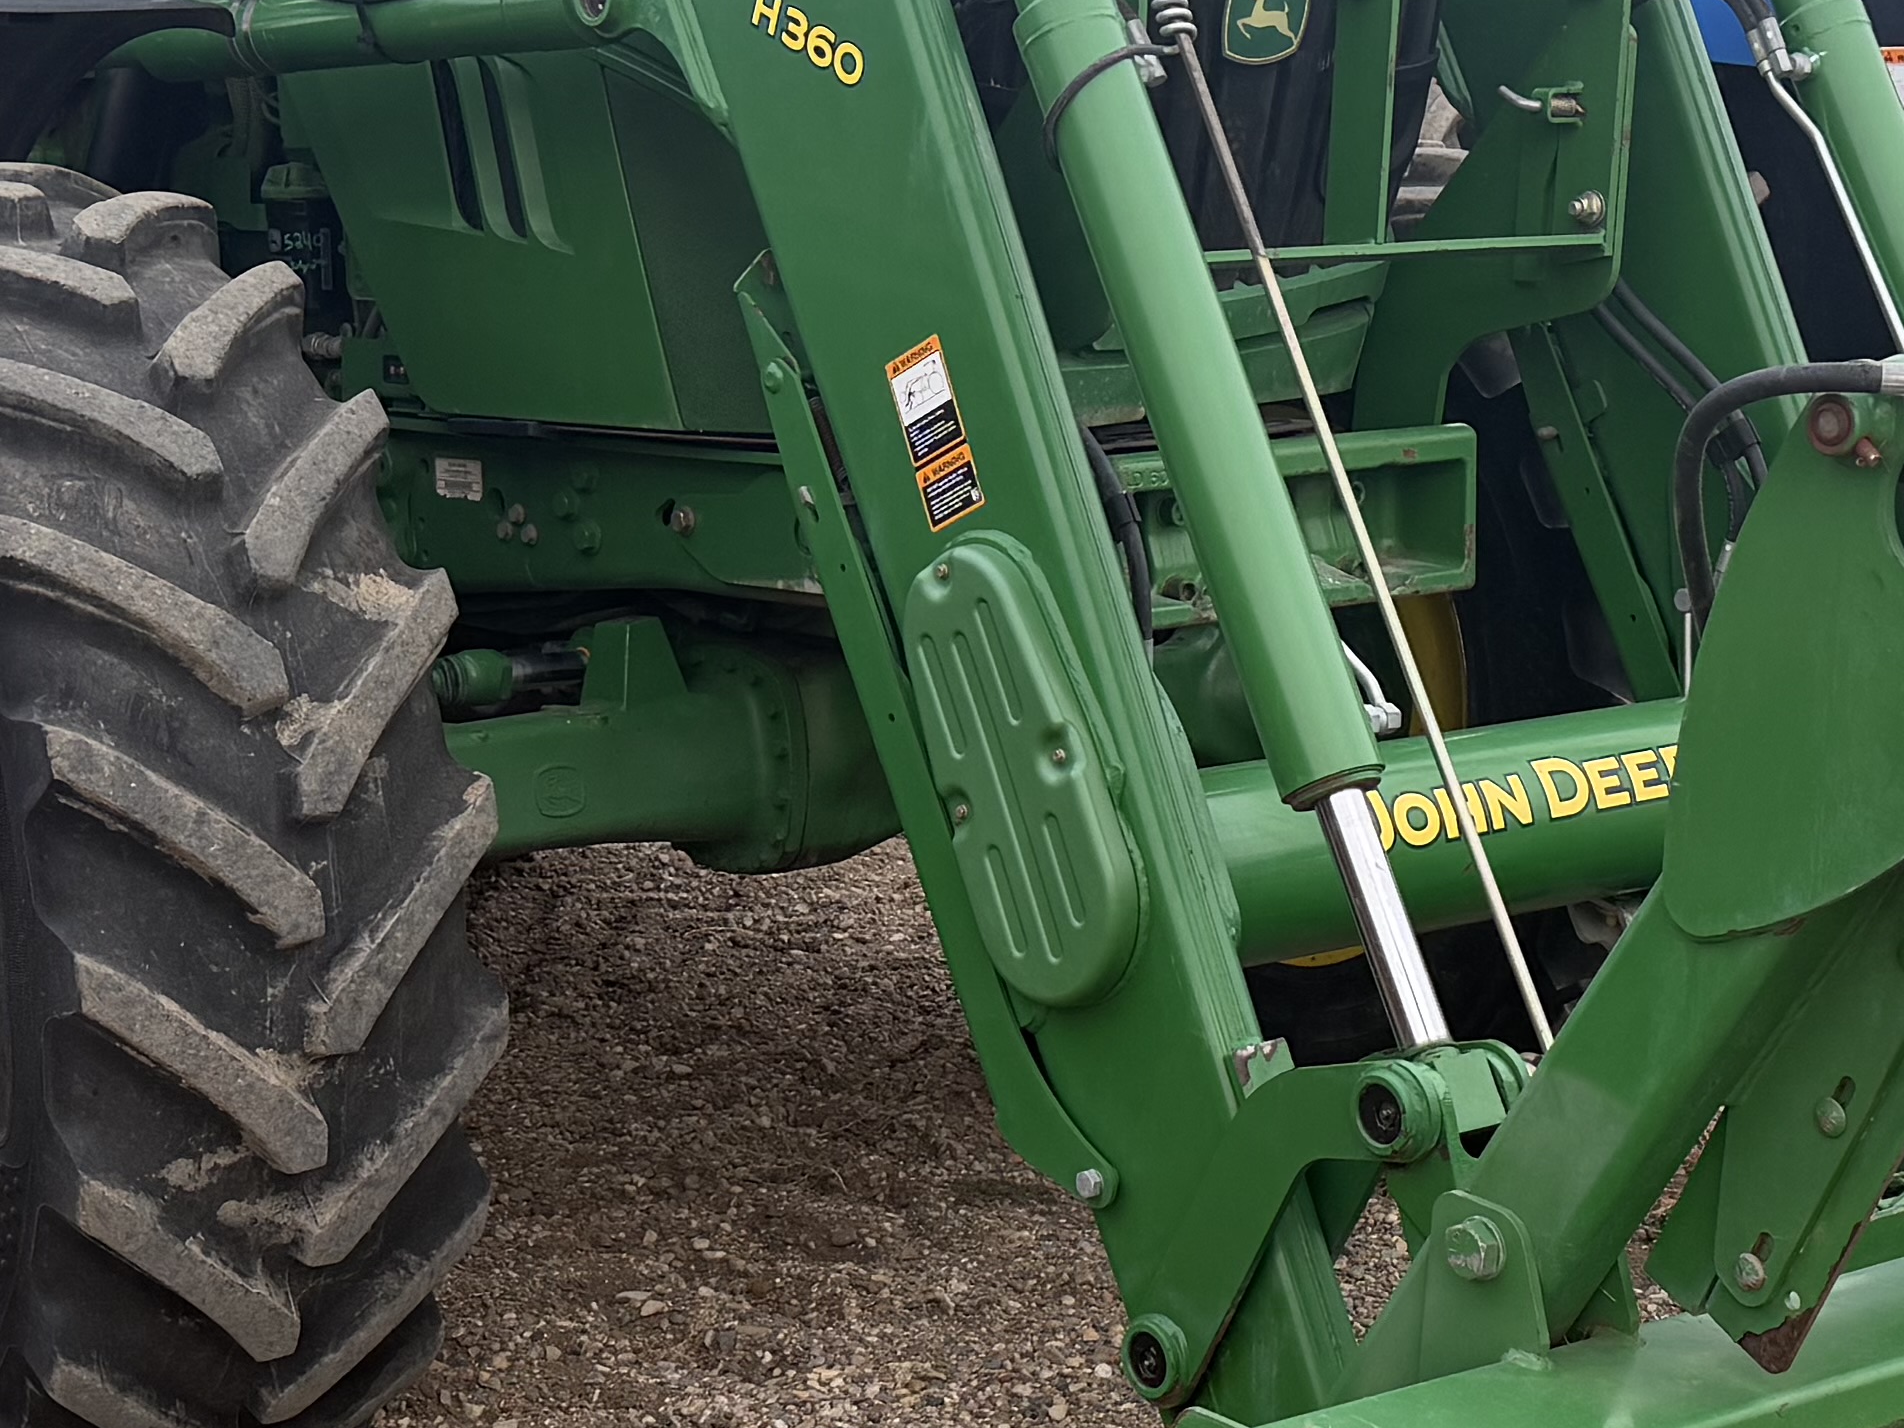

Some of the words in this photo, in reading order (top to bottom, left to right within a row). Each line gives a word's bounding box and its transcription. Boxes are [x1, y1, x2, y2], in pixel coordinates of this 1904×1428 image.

[899, 341, 934, 367] WARNING
[931, 451, 966, 477] WARNING
[1365, 773, 1534, 853] JOHN
